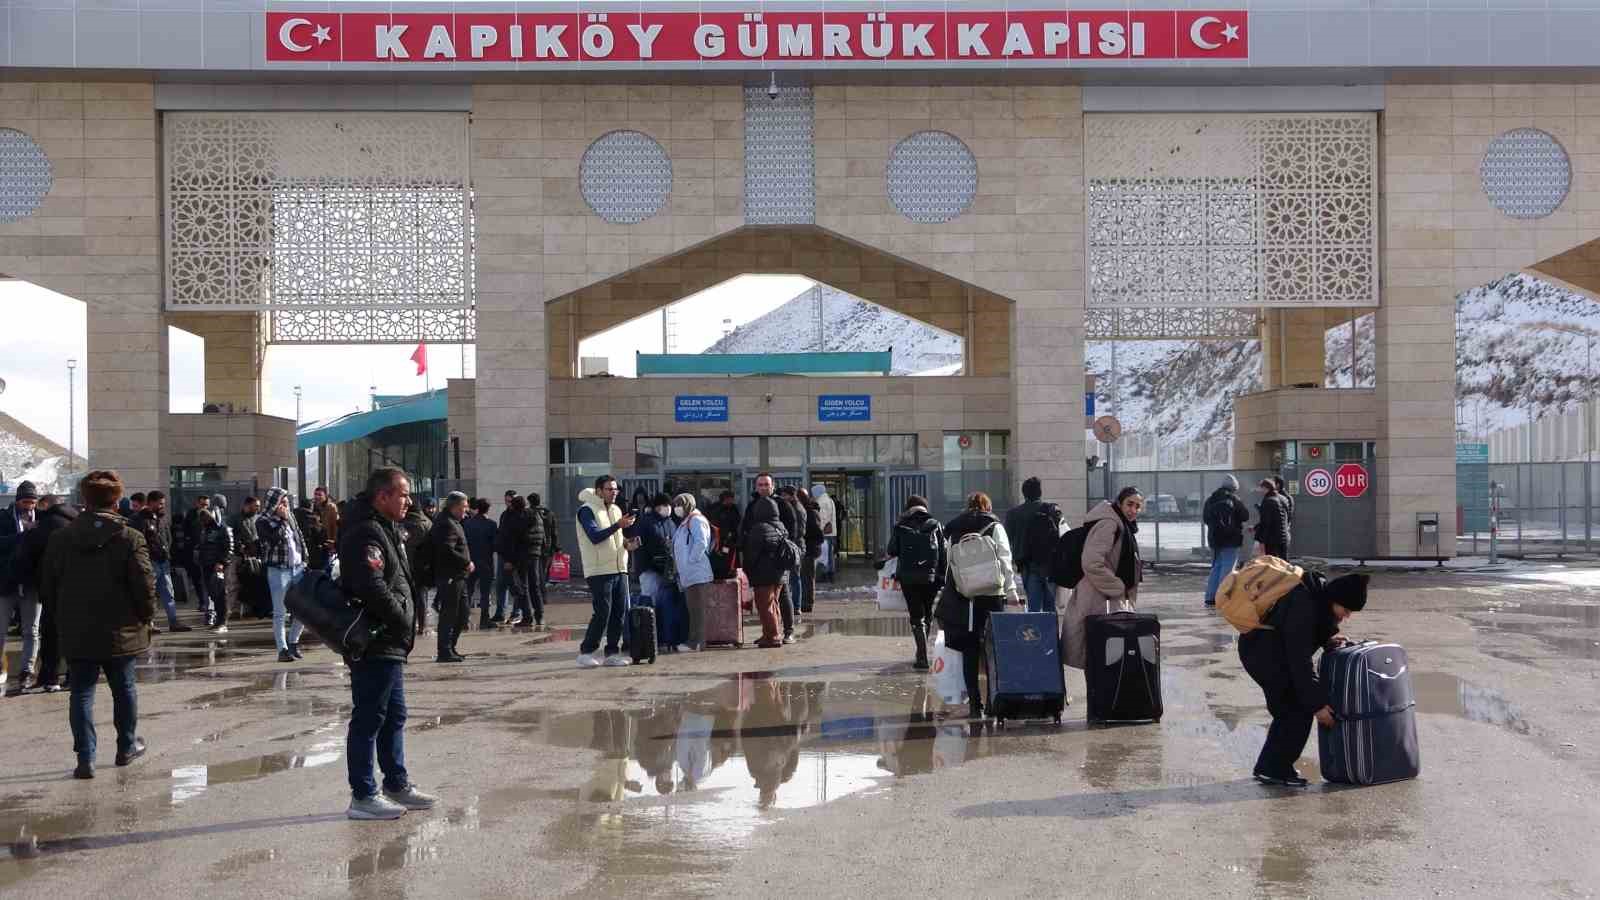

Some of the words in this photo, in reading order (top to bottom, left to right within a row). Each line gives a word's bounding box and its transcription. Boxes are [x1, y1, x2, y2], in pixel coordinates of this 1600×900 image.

[374, 12, 664, 59] KAPIKÖY
[693, 12, 936, 58] GÜMRÜK
[956, 21, 1146, 57] KAPISI
[1311, 478, 1327, 488] 30
[1337, 473, 1366, 488] DUR
